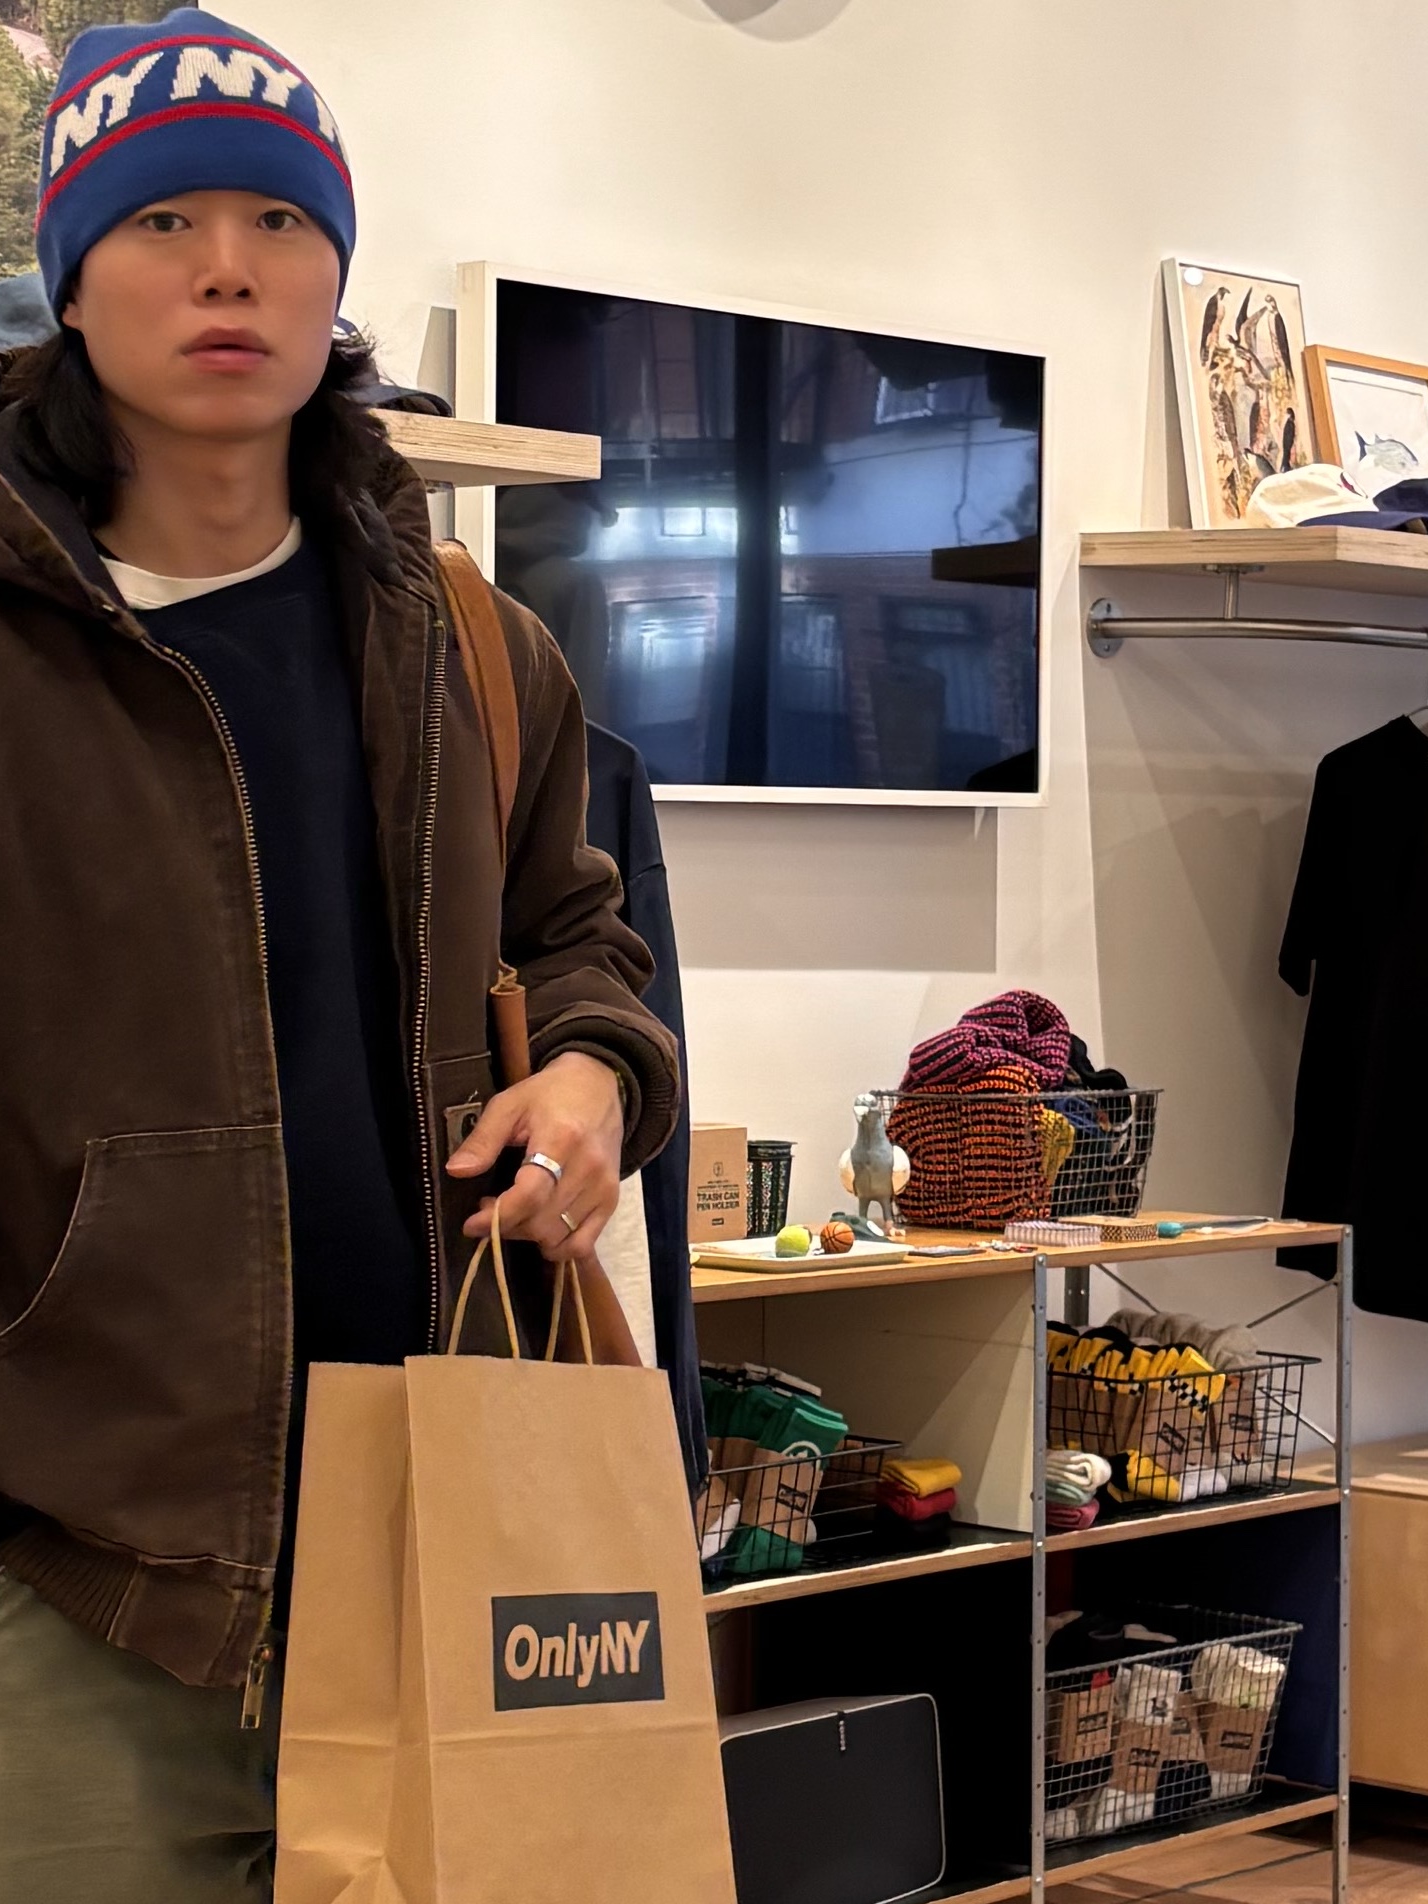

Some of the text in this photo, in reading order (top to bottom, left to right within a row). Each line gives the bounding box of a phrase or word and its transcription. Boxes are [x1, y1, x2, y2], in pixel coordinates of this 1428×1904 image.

[50, 51, 164, 177] NY
[170, 46, 304, 108] NY
[504, 1619, 650, 1688] OnlyNY
